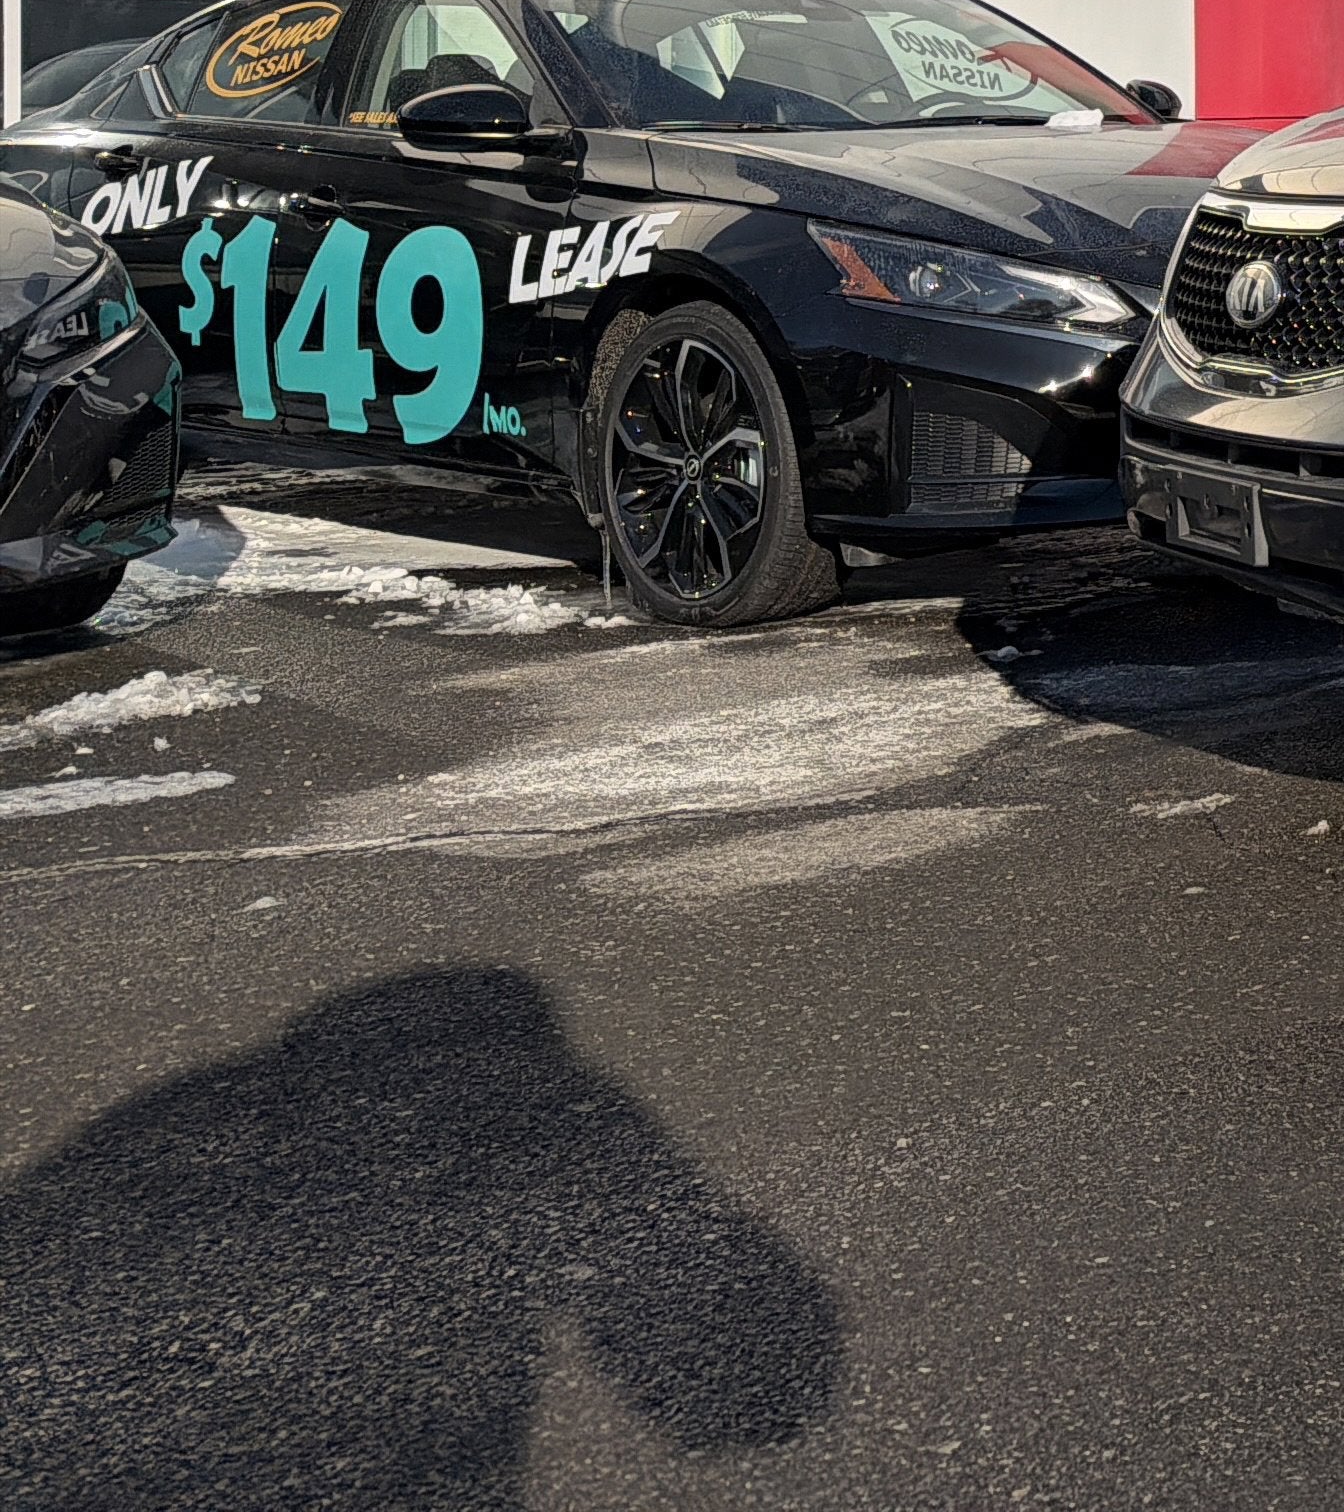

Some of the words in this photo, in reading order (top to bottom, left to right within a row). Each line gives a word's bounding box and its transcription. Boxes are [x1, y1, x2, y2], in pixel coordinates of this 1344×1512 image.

[227, 12, 343, 67] Romeo
[230, 48, 306, 87] NISSAN
[81, 155, 215, 236] ONLY
[509, 211, 682, 304] LEASE
[1230, 276, 1266, 313] KIA
[179, 215, 484, 445] $149
